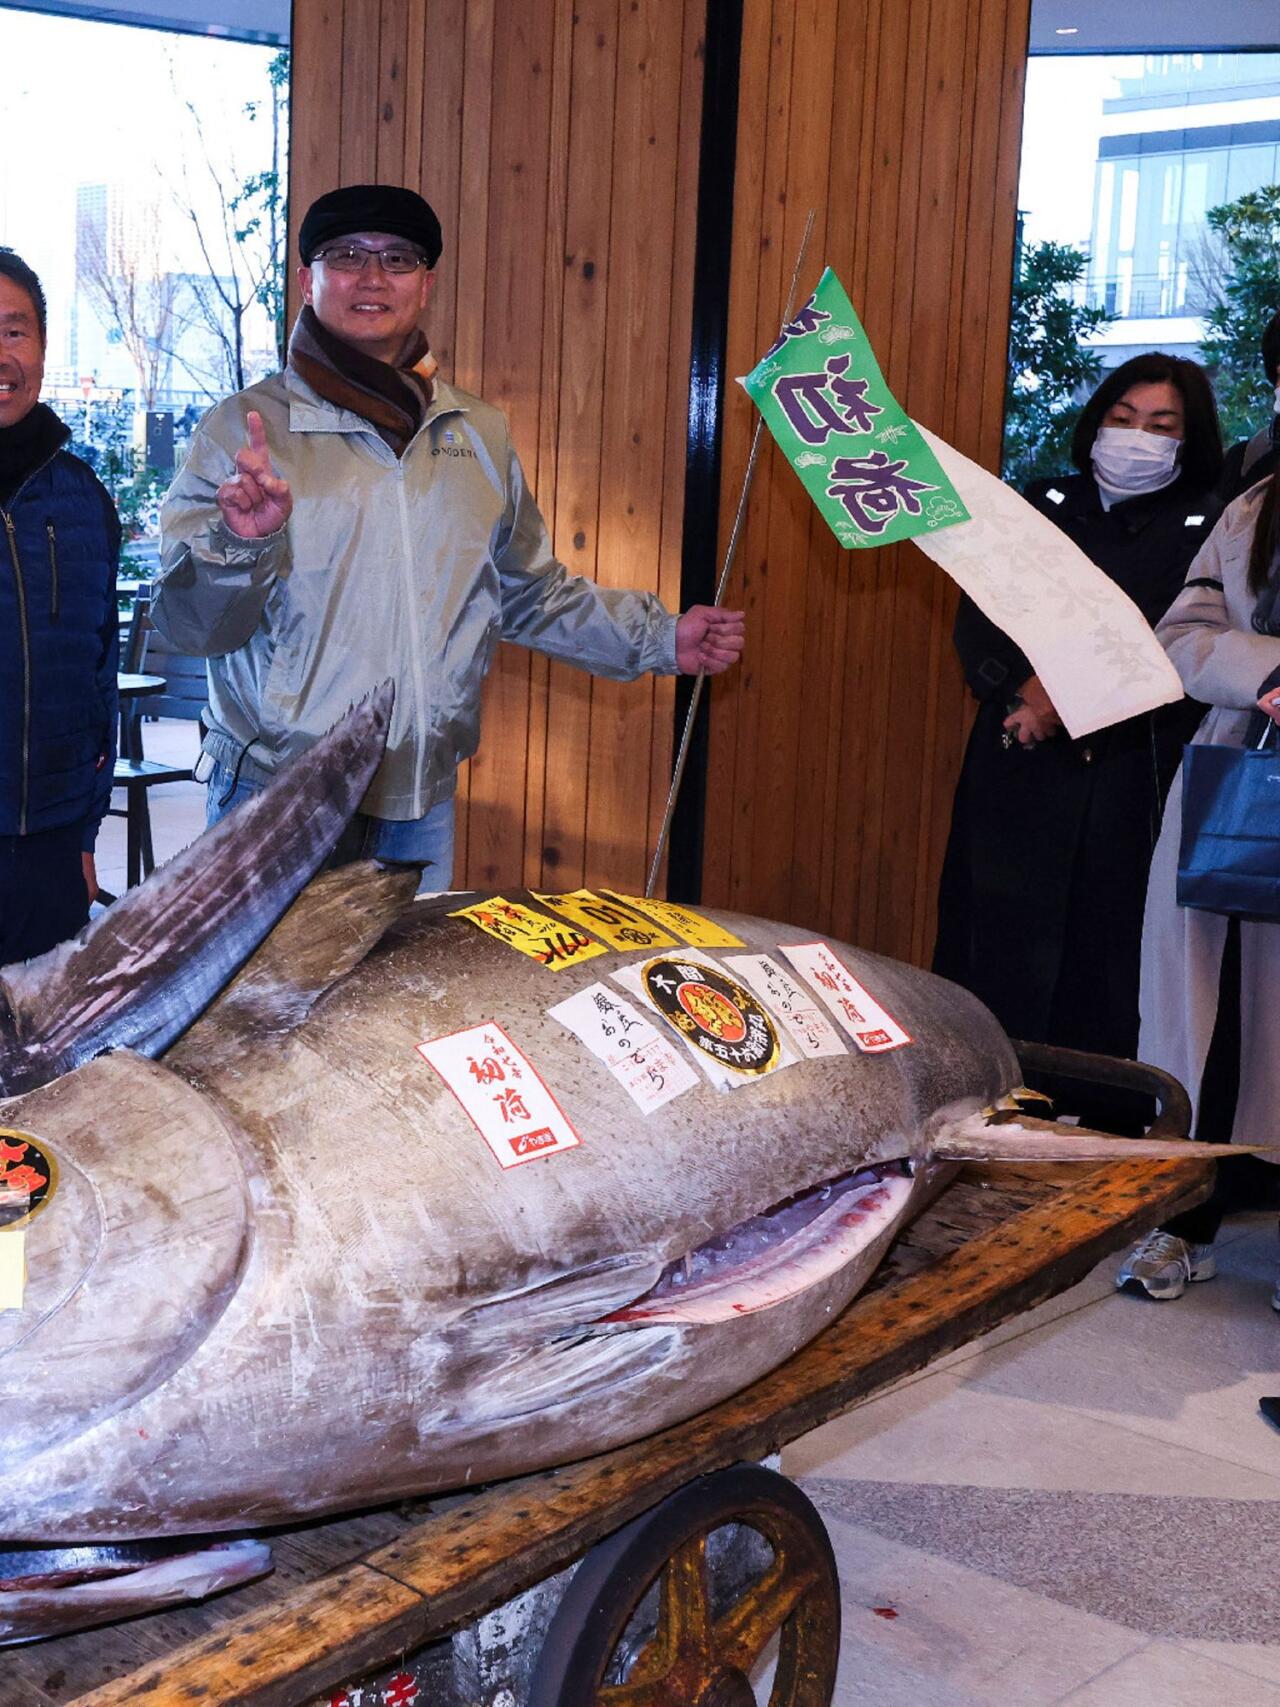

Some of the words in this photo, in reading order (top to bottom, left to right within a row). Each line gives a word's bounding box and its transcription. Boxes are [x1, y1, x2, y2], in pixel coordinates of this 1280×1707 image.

[649, 965, 706, 995] 大間
[809, 966, 867, 1024] 初荷
[601, 1018, 665, 1092] おのでら
[466, 1056, 532, 1123] 初荷
